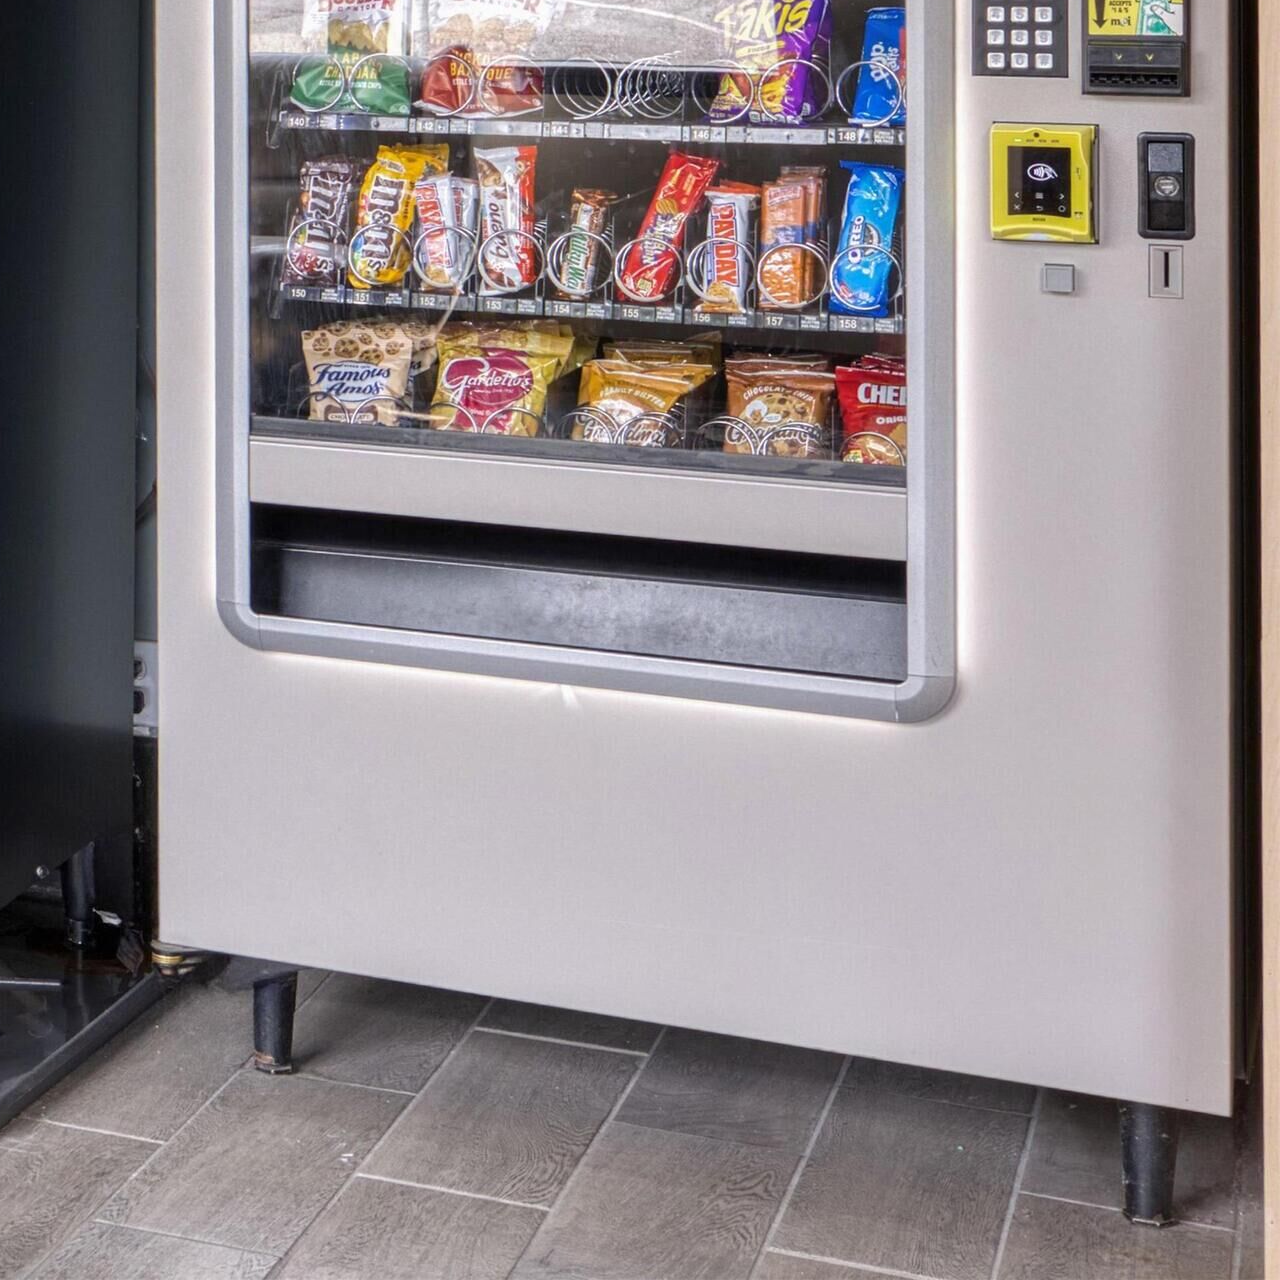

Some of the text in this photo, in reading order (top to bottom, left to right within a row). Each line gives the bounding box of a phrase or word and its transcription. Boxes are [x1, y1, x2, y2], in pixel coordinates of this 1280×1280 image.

[289, 117, 305, 127] 140
[418, 119, 434, 129] 142
[693, 129, 710, 140] 146
[838, 131, 857, 142] 148
[489, 202, 511, 260] bueno
[567, 223, 589, 261] Milky
[710, 202, 740, 287] PAYDAY
[847, 215, 866, 265] OREO
[291, 288, 307, 298] 150
[355, 293, 370, 302] 151
[419, 296, 436, 306] 152
[485, 301, 502, 311] 153
[553, 304, 570, 314] 154
[622, 308, 640, 318] 155
[694, 312, 711, 322] 156
[766, 316, 783, 326] 157
[839, 319, 857, 329] 158
[313, 363, 392, 386] Famous
[442, 356, 531, 404] Gardetto's
[315, 381, 385, 402] Amos
